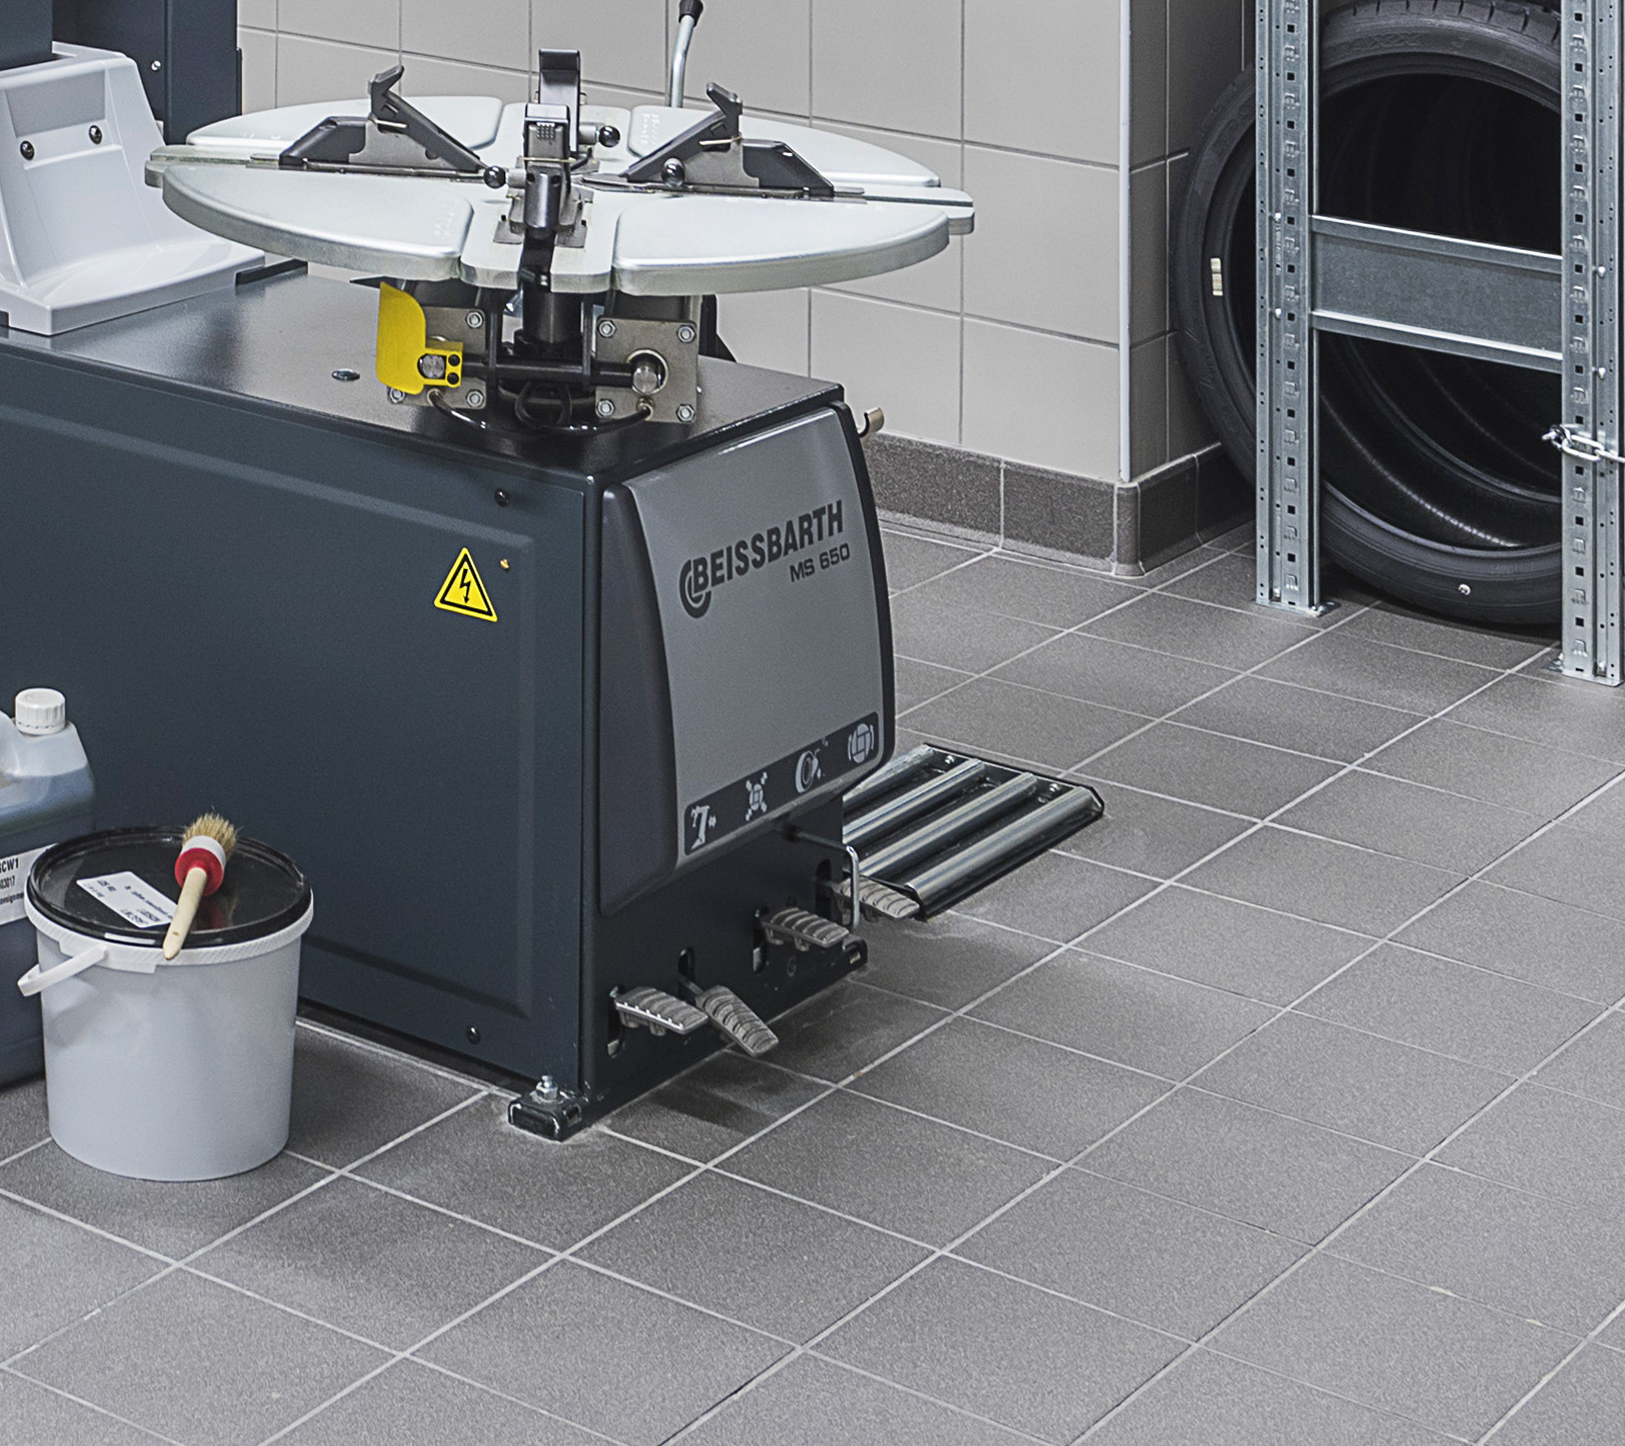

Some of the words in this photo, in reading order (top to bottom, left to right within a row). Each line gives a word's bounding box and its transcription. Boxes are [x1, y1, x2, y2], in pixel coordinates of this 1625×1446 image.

[693, 499, 844, 600] BEISSBARTH
[789, 558, 815, 583] MS
[820, 542, 851, 570] 650
